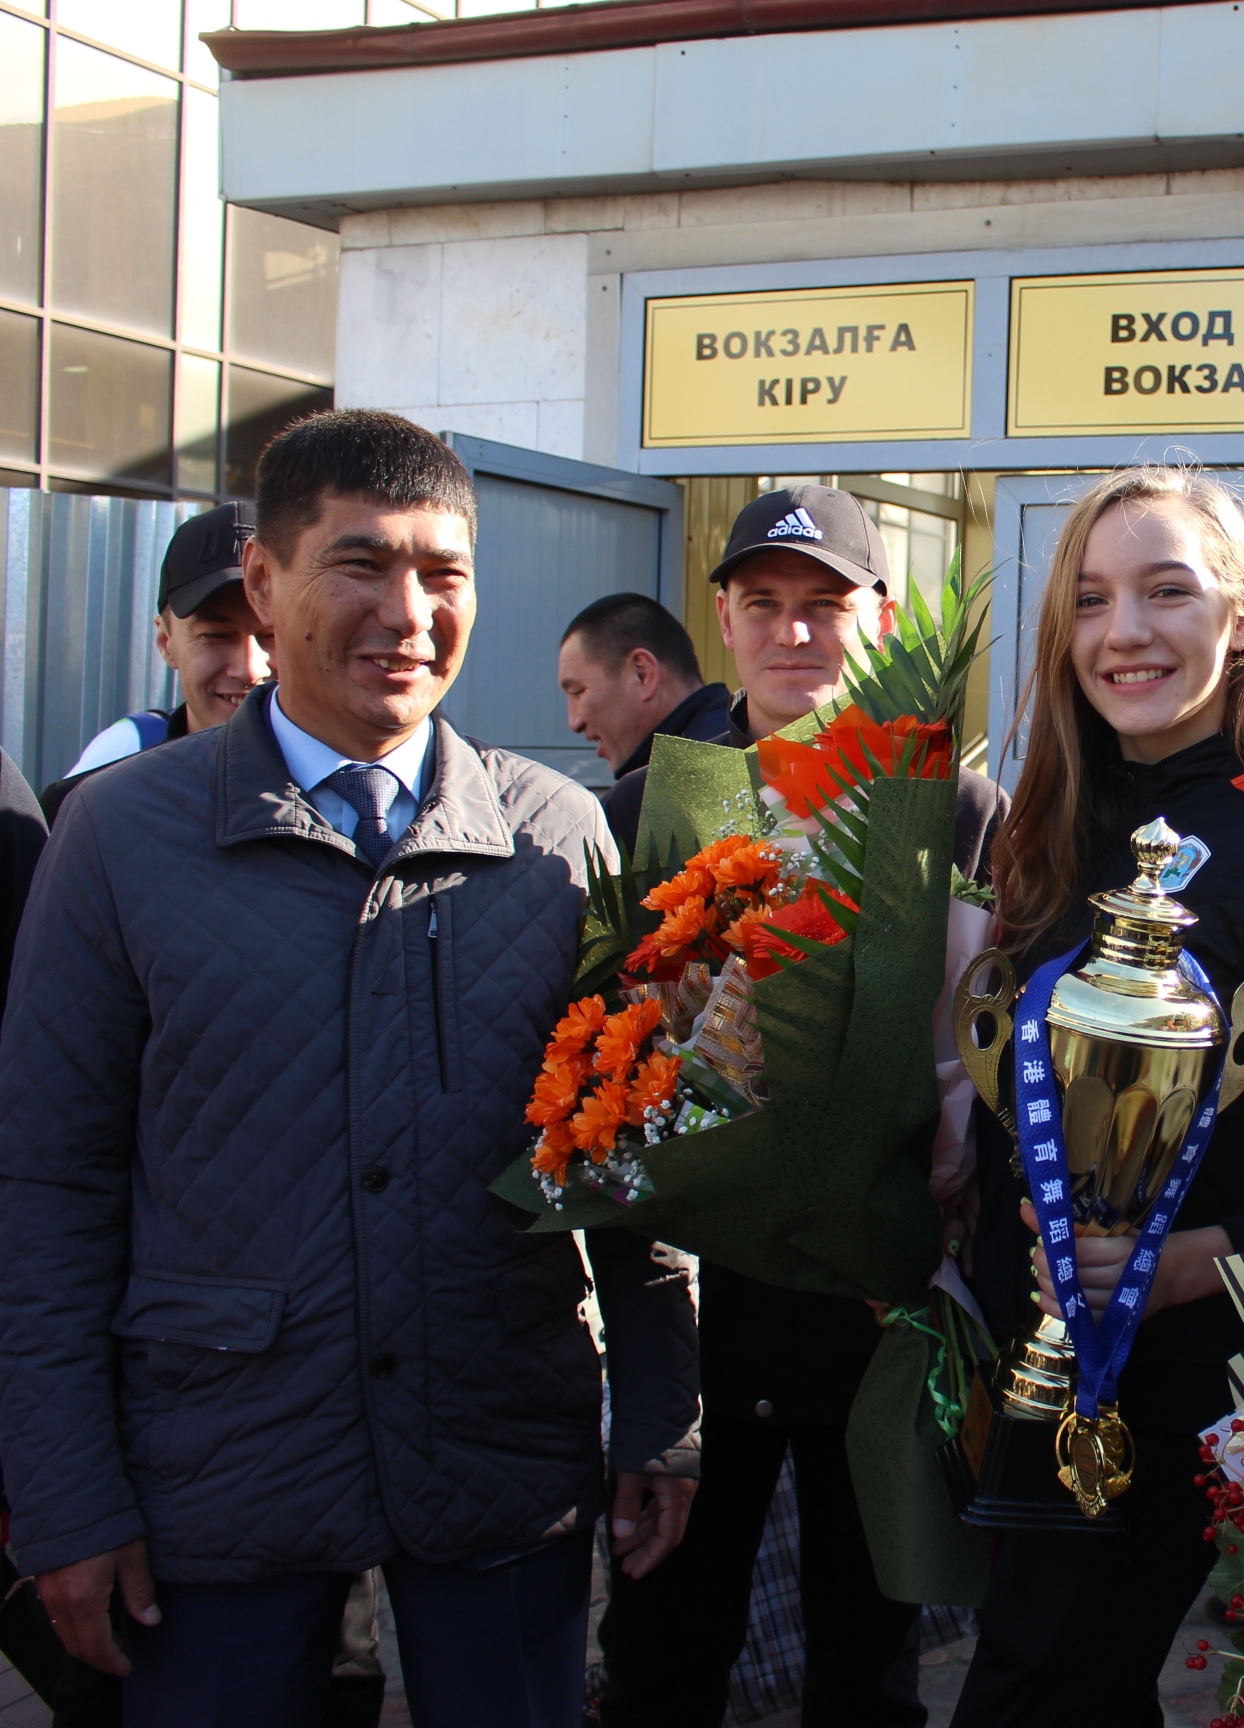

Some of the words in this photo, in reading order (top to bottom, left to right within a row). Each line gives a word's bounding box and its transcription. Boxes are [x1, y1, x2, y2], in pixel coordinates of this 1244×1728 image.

[695, 323, 917, 361] ВОКЗАЛҒА
[1110, 311, 1234, 347] ВХОД
[757, 375, 848, 407] КІРУ
[767, 524, 823, 541] adidas
